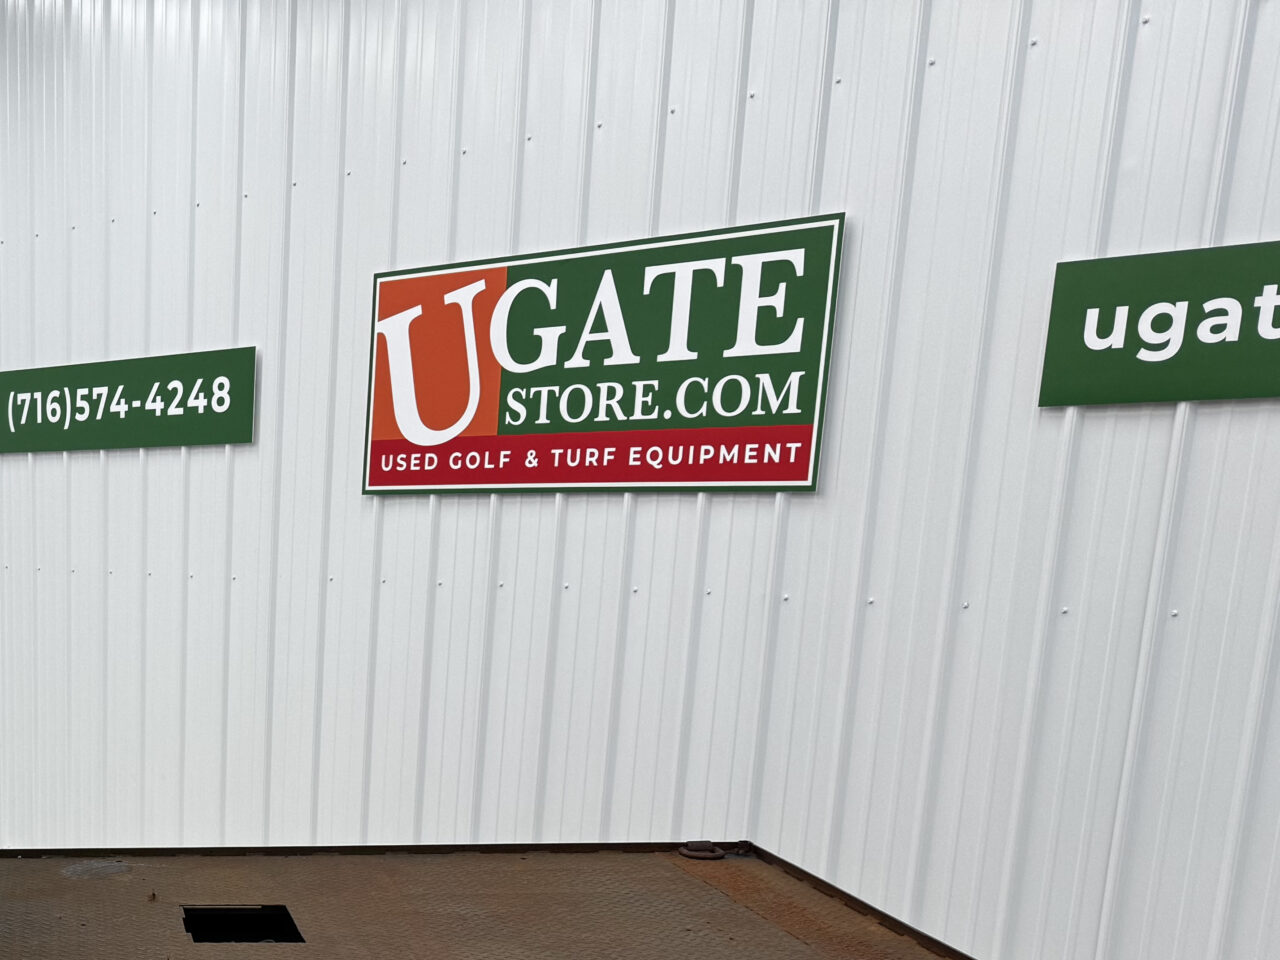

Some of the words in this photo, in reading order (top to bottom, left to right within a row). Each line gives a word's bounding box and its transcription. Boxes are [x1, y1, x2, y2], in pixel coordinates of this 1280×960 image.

[377, 247, 806, 447] UGATE
[1083, 283, 1280, 363] ugat
[7, 375, 231, 433] (716)574-4248
[505, 370, 806, 426] STORE.COM
[380, 452, 438, 472] USED
[448, 449, 512, 470] GOLF
[524, 449, 540, 468] &
[550, 446, 616, 467] TURF
[628, 442, 803, 468] EQUIPMENT
